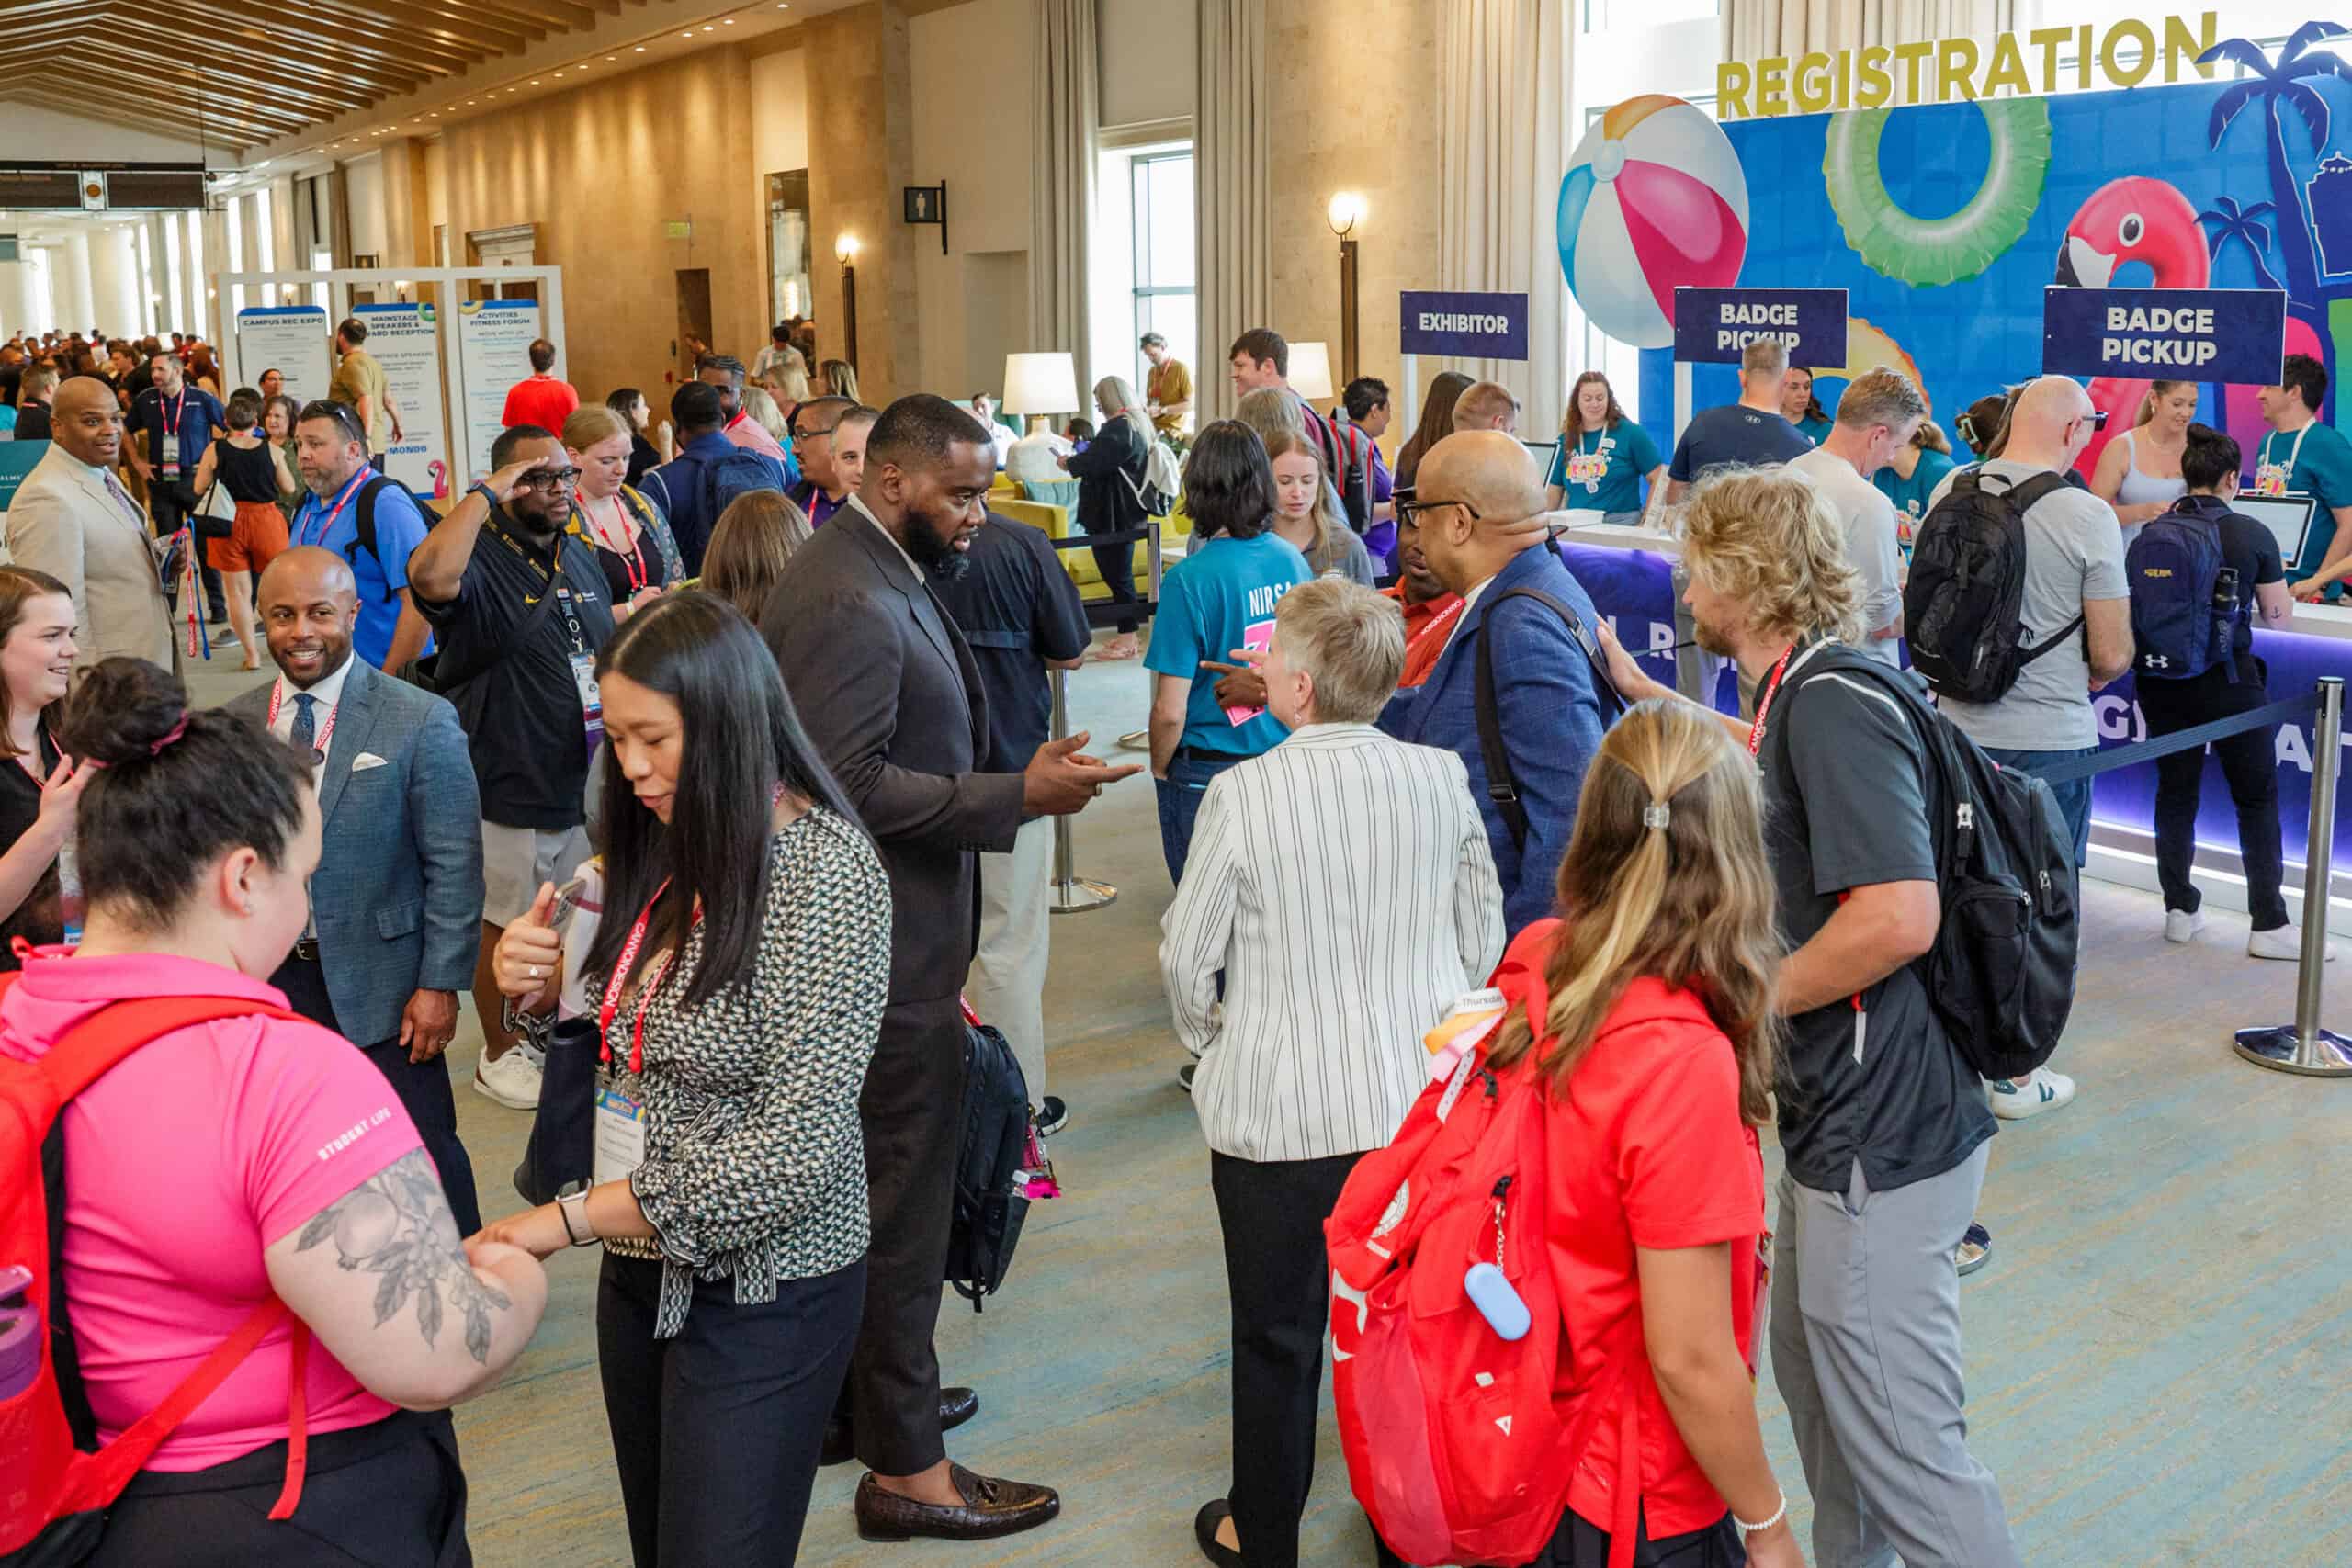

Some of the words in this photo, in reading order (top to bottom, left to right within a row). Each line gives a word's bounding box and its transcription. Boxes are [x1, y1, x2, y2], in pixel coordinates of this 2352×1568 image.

[1716, 11, 2217, 119] REGISTRATION
[1418, 312, 1509, 334] EXHIBITOR
[1720, 303, 1799, 326] BADGE
[2106, 306, 2215, 334] BADGE
[2101, 337, 2218, 366] PICKUP
[1249, 581, 1293, 618] NIRS
[605, 921, 646, 1008] CANNONDESIGN
[316, 1119, 370, 1161] STUDENT
